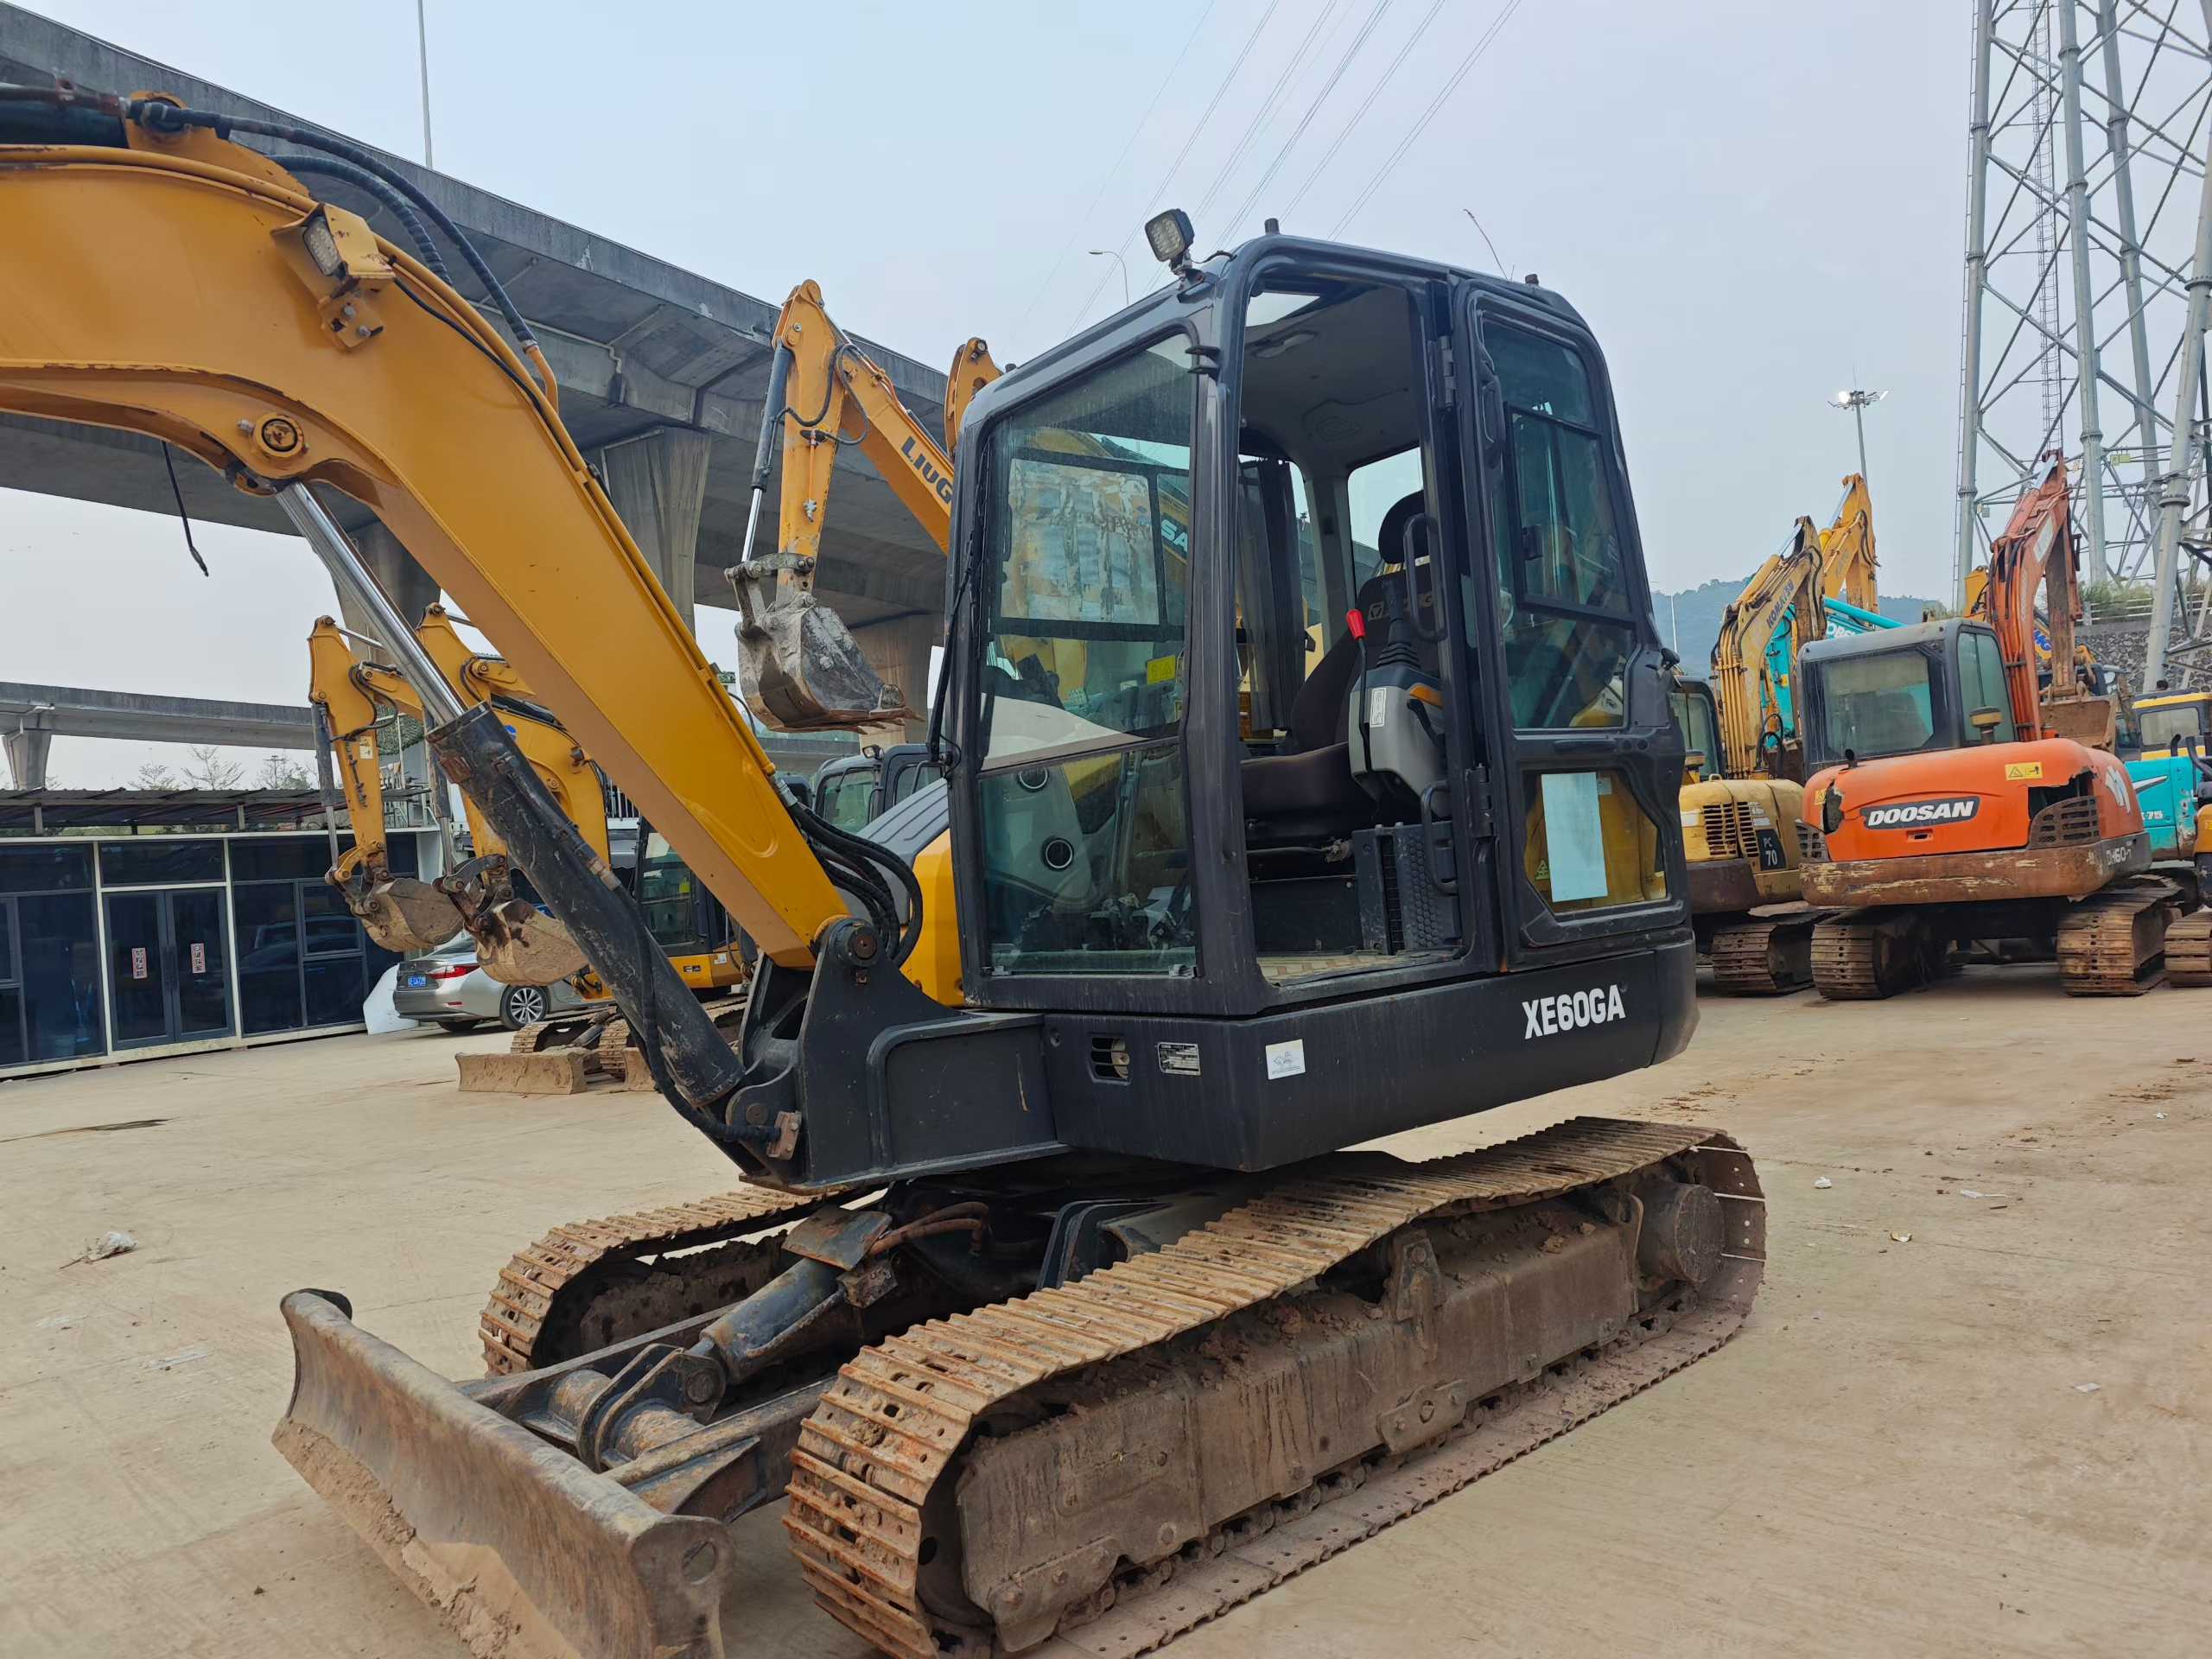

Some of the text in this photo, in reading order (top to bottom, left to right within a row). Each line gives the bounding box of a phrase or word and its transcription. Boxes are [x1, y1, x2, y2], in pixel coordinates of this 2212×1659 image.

[901, 435, 954, 504] LIUG
[1867, 800, 1974, 826] DOOSAN
[1764, 836, 1773, 848] PC
[1766, 849, 1778, 866] 70
[1522, 984, 1626, 1040] XE60GA
